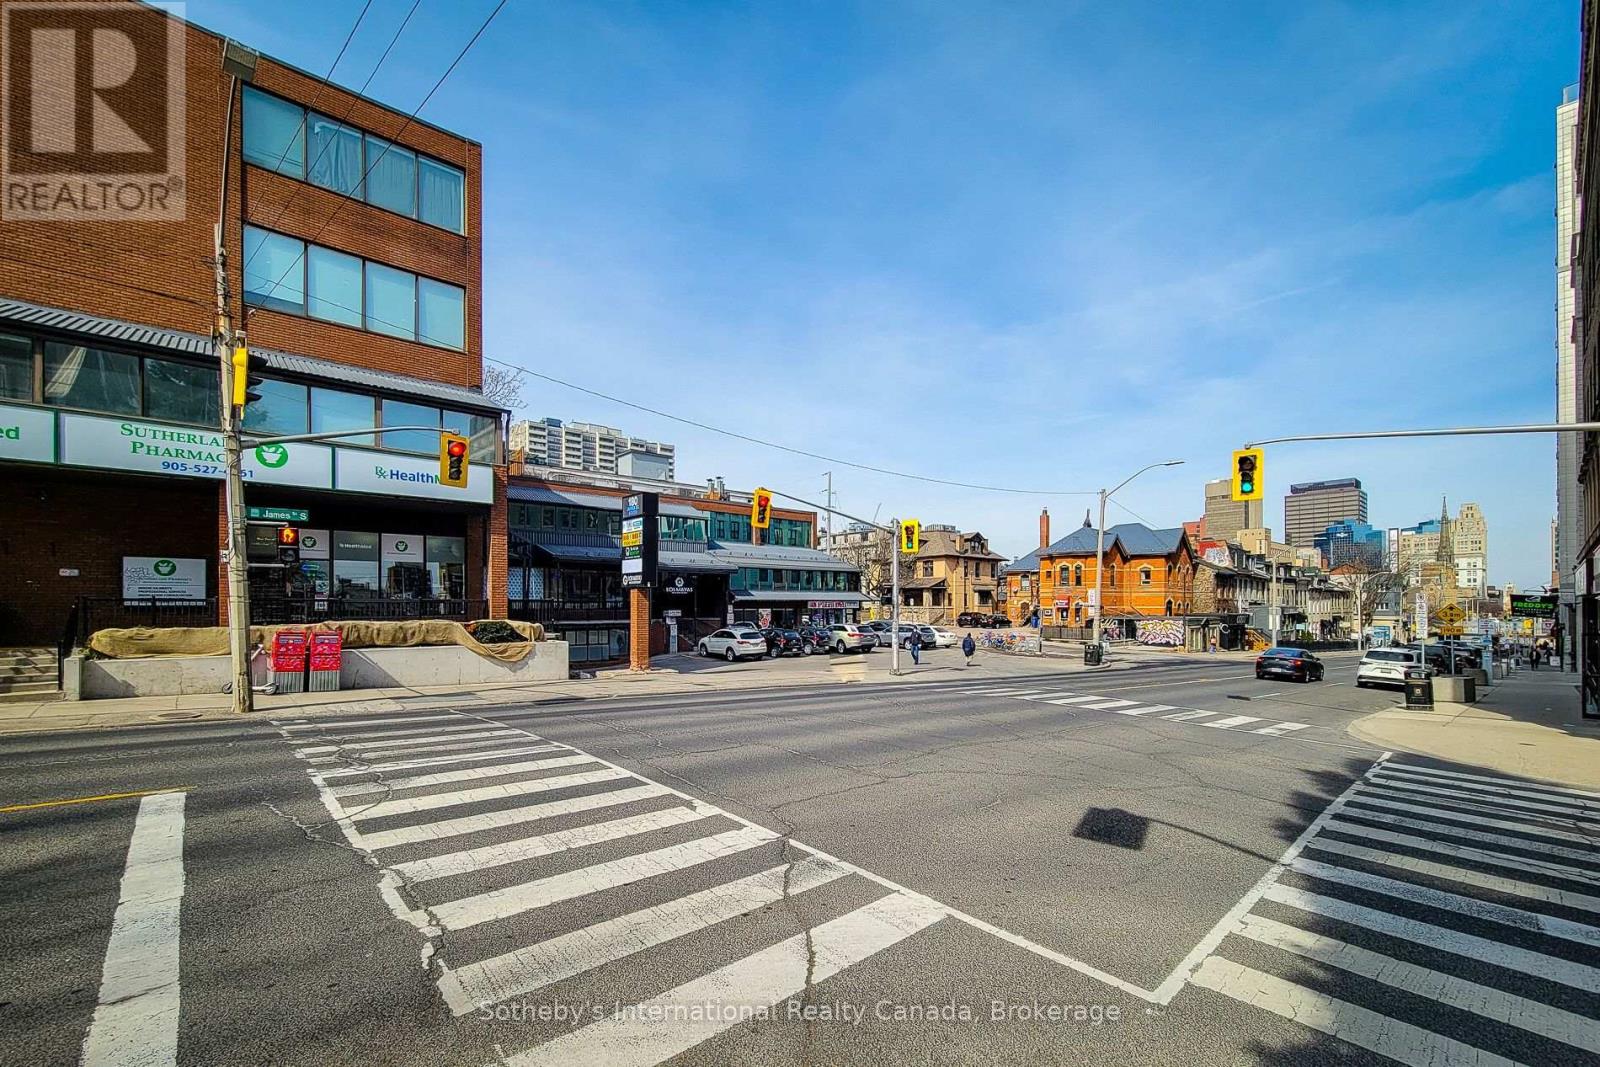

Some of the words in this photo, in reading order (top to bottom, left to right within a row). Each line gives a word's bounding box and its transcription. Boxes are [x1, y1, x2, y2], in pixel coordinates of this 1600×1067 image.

[120, 424, 224, 447] SUTHERLA
[130, 441, 226, 463] PHARMAC
[162, 461, 253, 478] 905-527-61
[390, 469, 440, 483] HealthM
[263, 510, 290, 519] James
[300, 512, 307, 520] S
